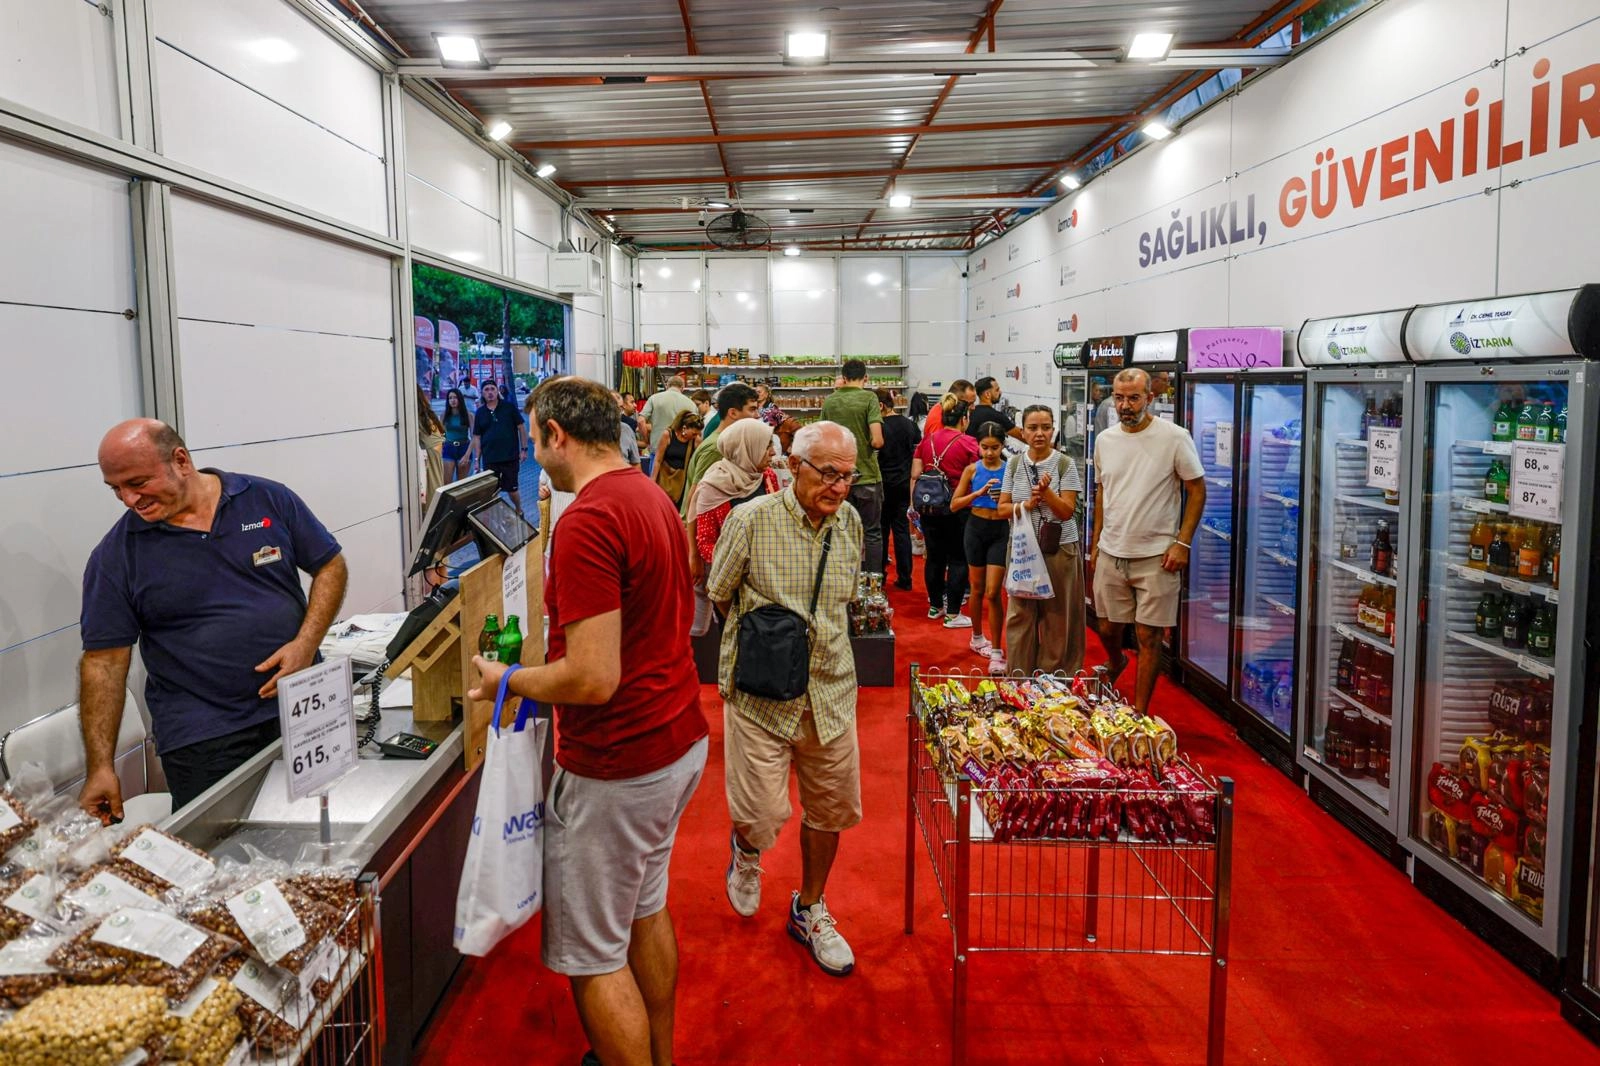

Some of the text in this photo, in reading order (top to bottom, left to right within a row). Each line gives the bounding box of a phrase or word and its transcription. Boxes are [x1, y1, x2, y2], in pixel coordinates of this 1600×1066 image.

[1138, 57, 1600, 269] SAĞLIKLI, GÜVENİLİR
[1524, 458, 1540, 472] 68,
[1522, 491, 1538, 506] 87,
[291, 693, 336, 718] 475, 00
[293, 744, 329, 775] 615,
